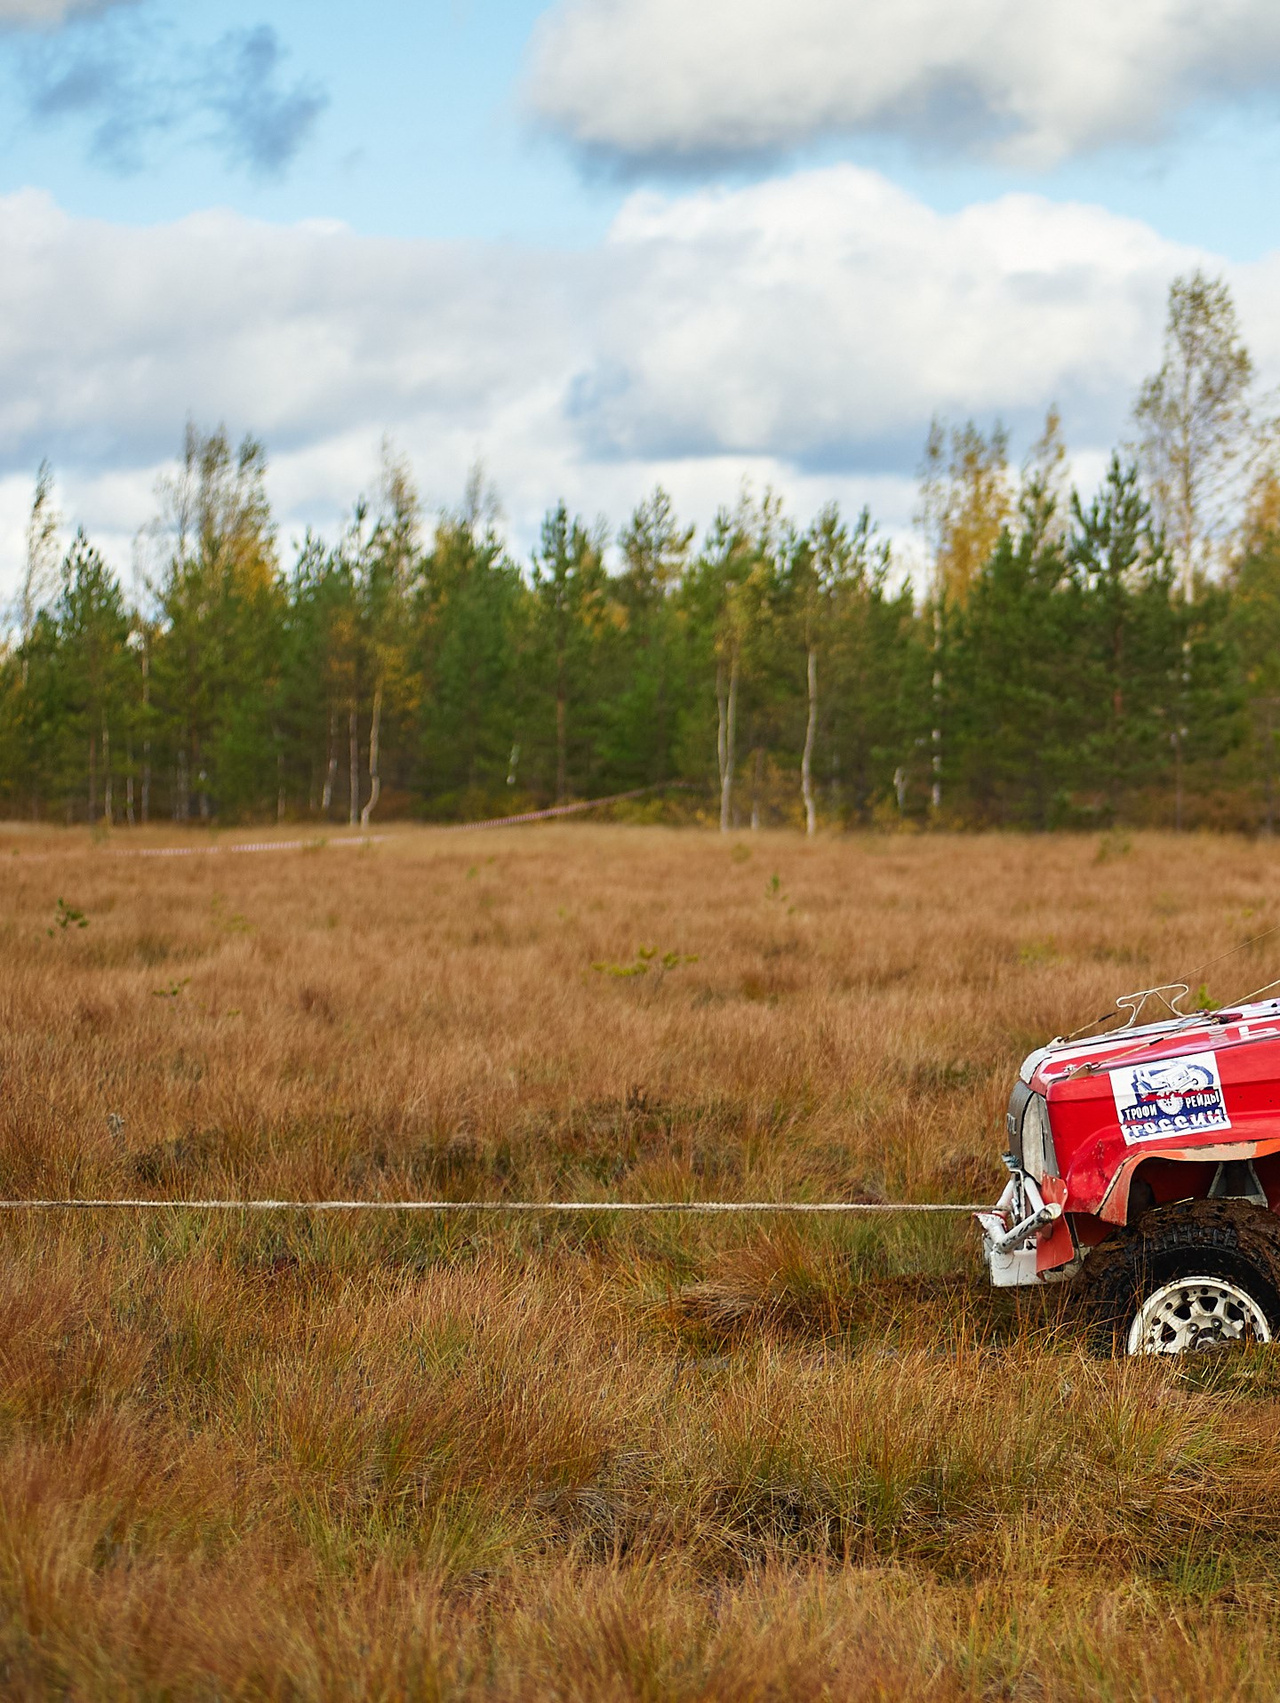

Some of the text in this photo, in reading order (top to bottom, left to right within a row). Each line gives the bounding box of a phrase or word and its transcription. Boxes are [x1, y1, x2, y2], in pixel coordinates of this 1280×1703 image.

[1124, 1090, 1221, 1121] ТРОФИ РЕЙДЫ
[1130, 1109, 1226, 1138] РОССИИ
